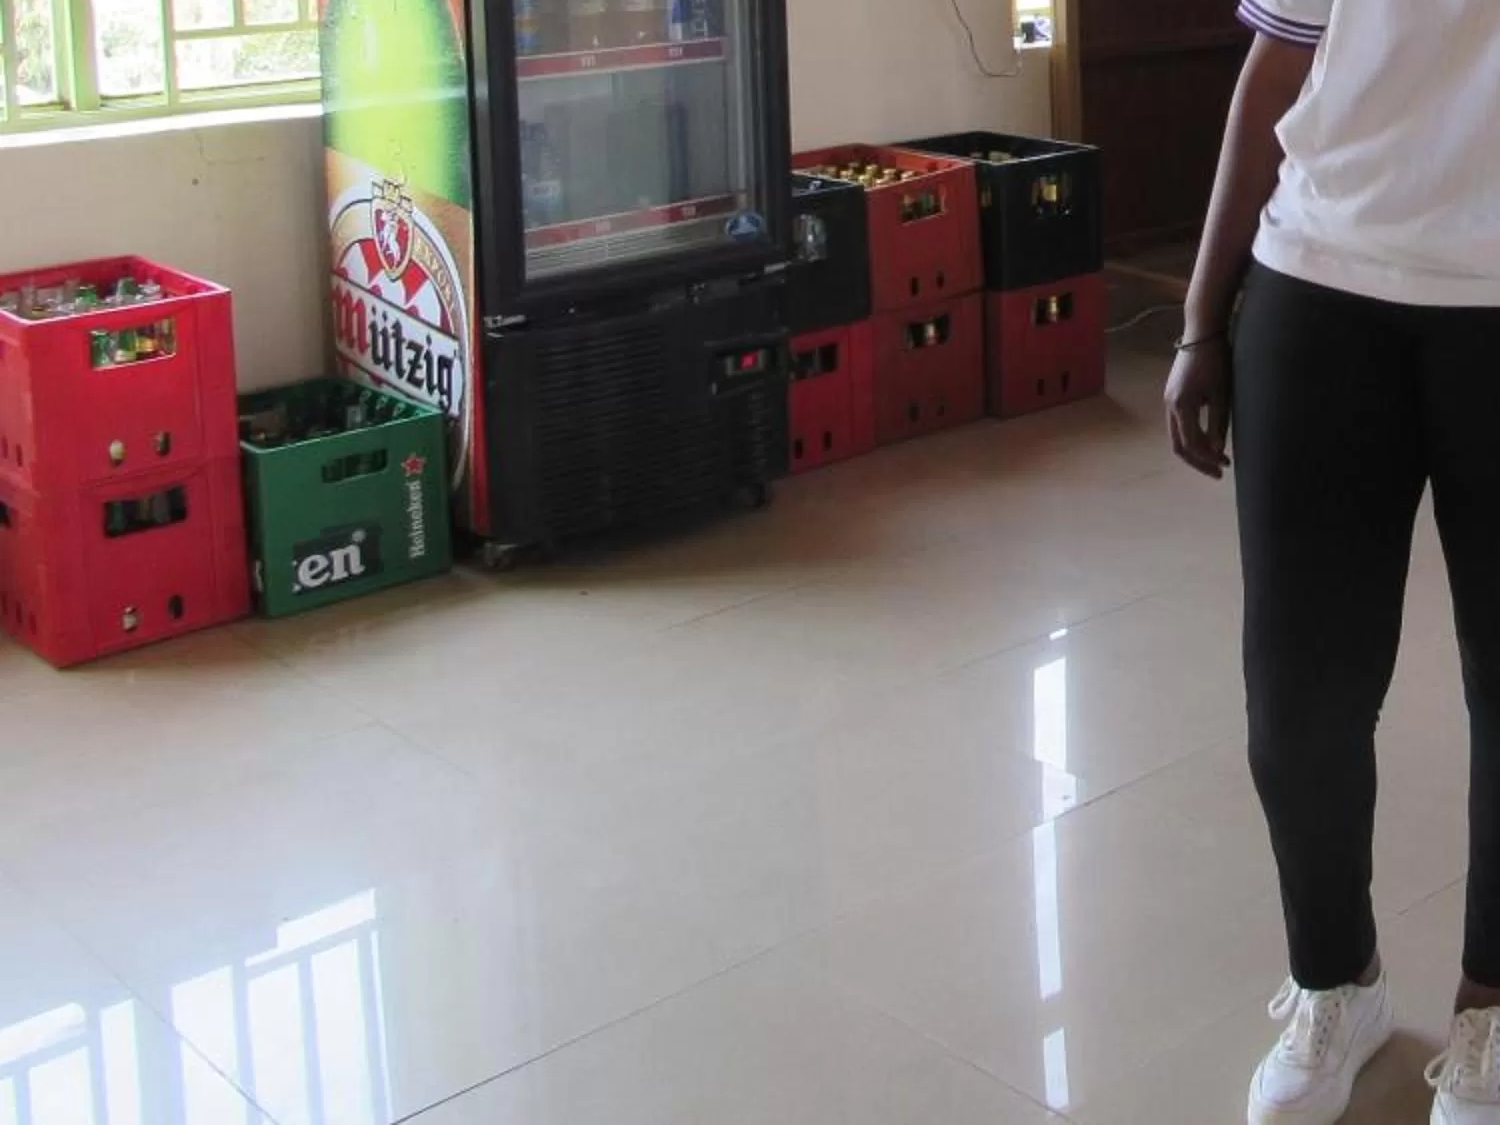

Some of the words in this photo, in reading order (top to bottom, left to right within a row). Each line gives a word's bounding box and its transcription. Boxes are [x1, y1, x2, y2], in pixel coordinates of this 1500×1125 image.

[332, 280, 457, 413] Mützig
[404, 480, 426, 560] Heineken
[292, 542, 366, 594] en
